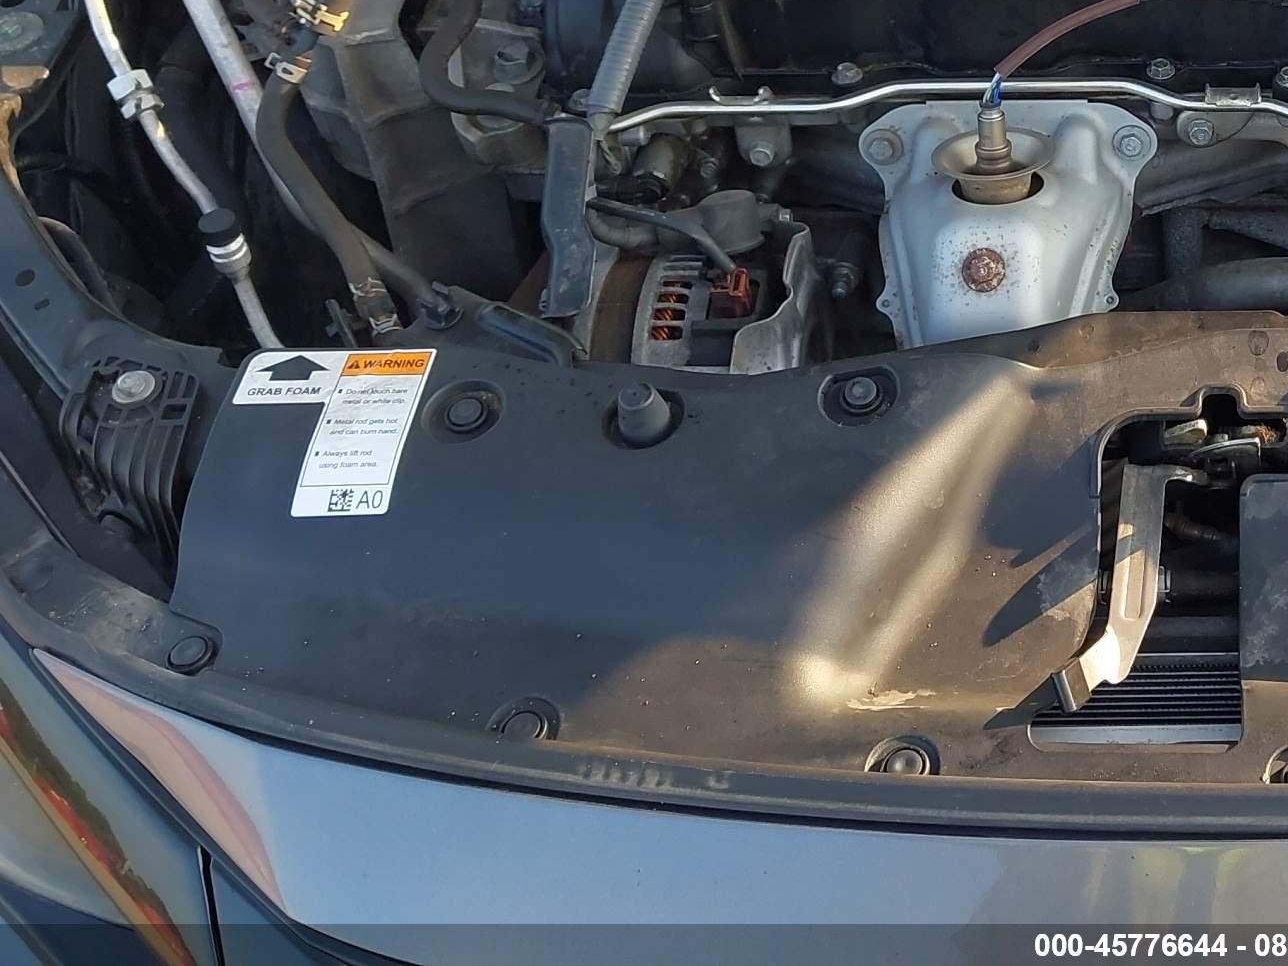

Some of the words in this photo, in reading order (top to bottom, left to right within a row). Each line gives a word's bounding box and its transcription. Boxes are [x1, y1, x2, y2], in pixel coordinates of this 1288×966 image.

[363, 359, 425, 369] WARNING
[247, 387, 283, 396] GRAB
[284, 387, 322, 395] FOAM
